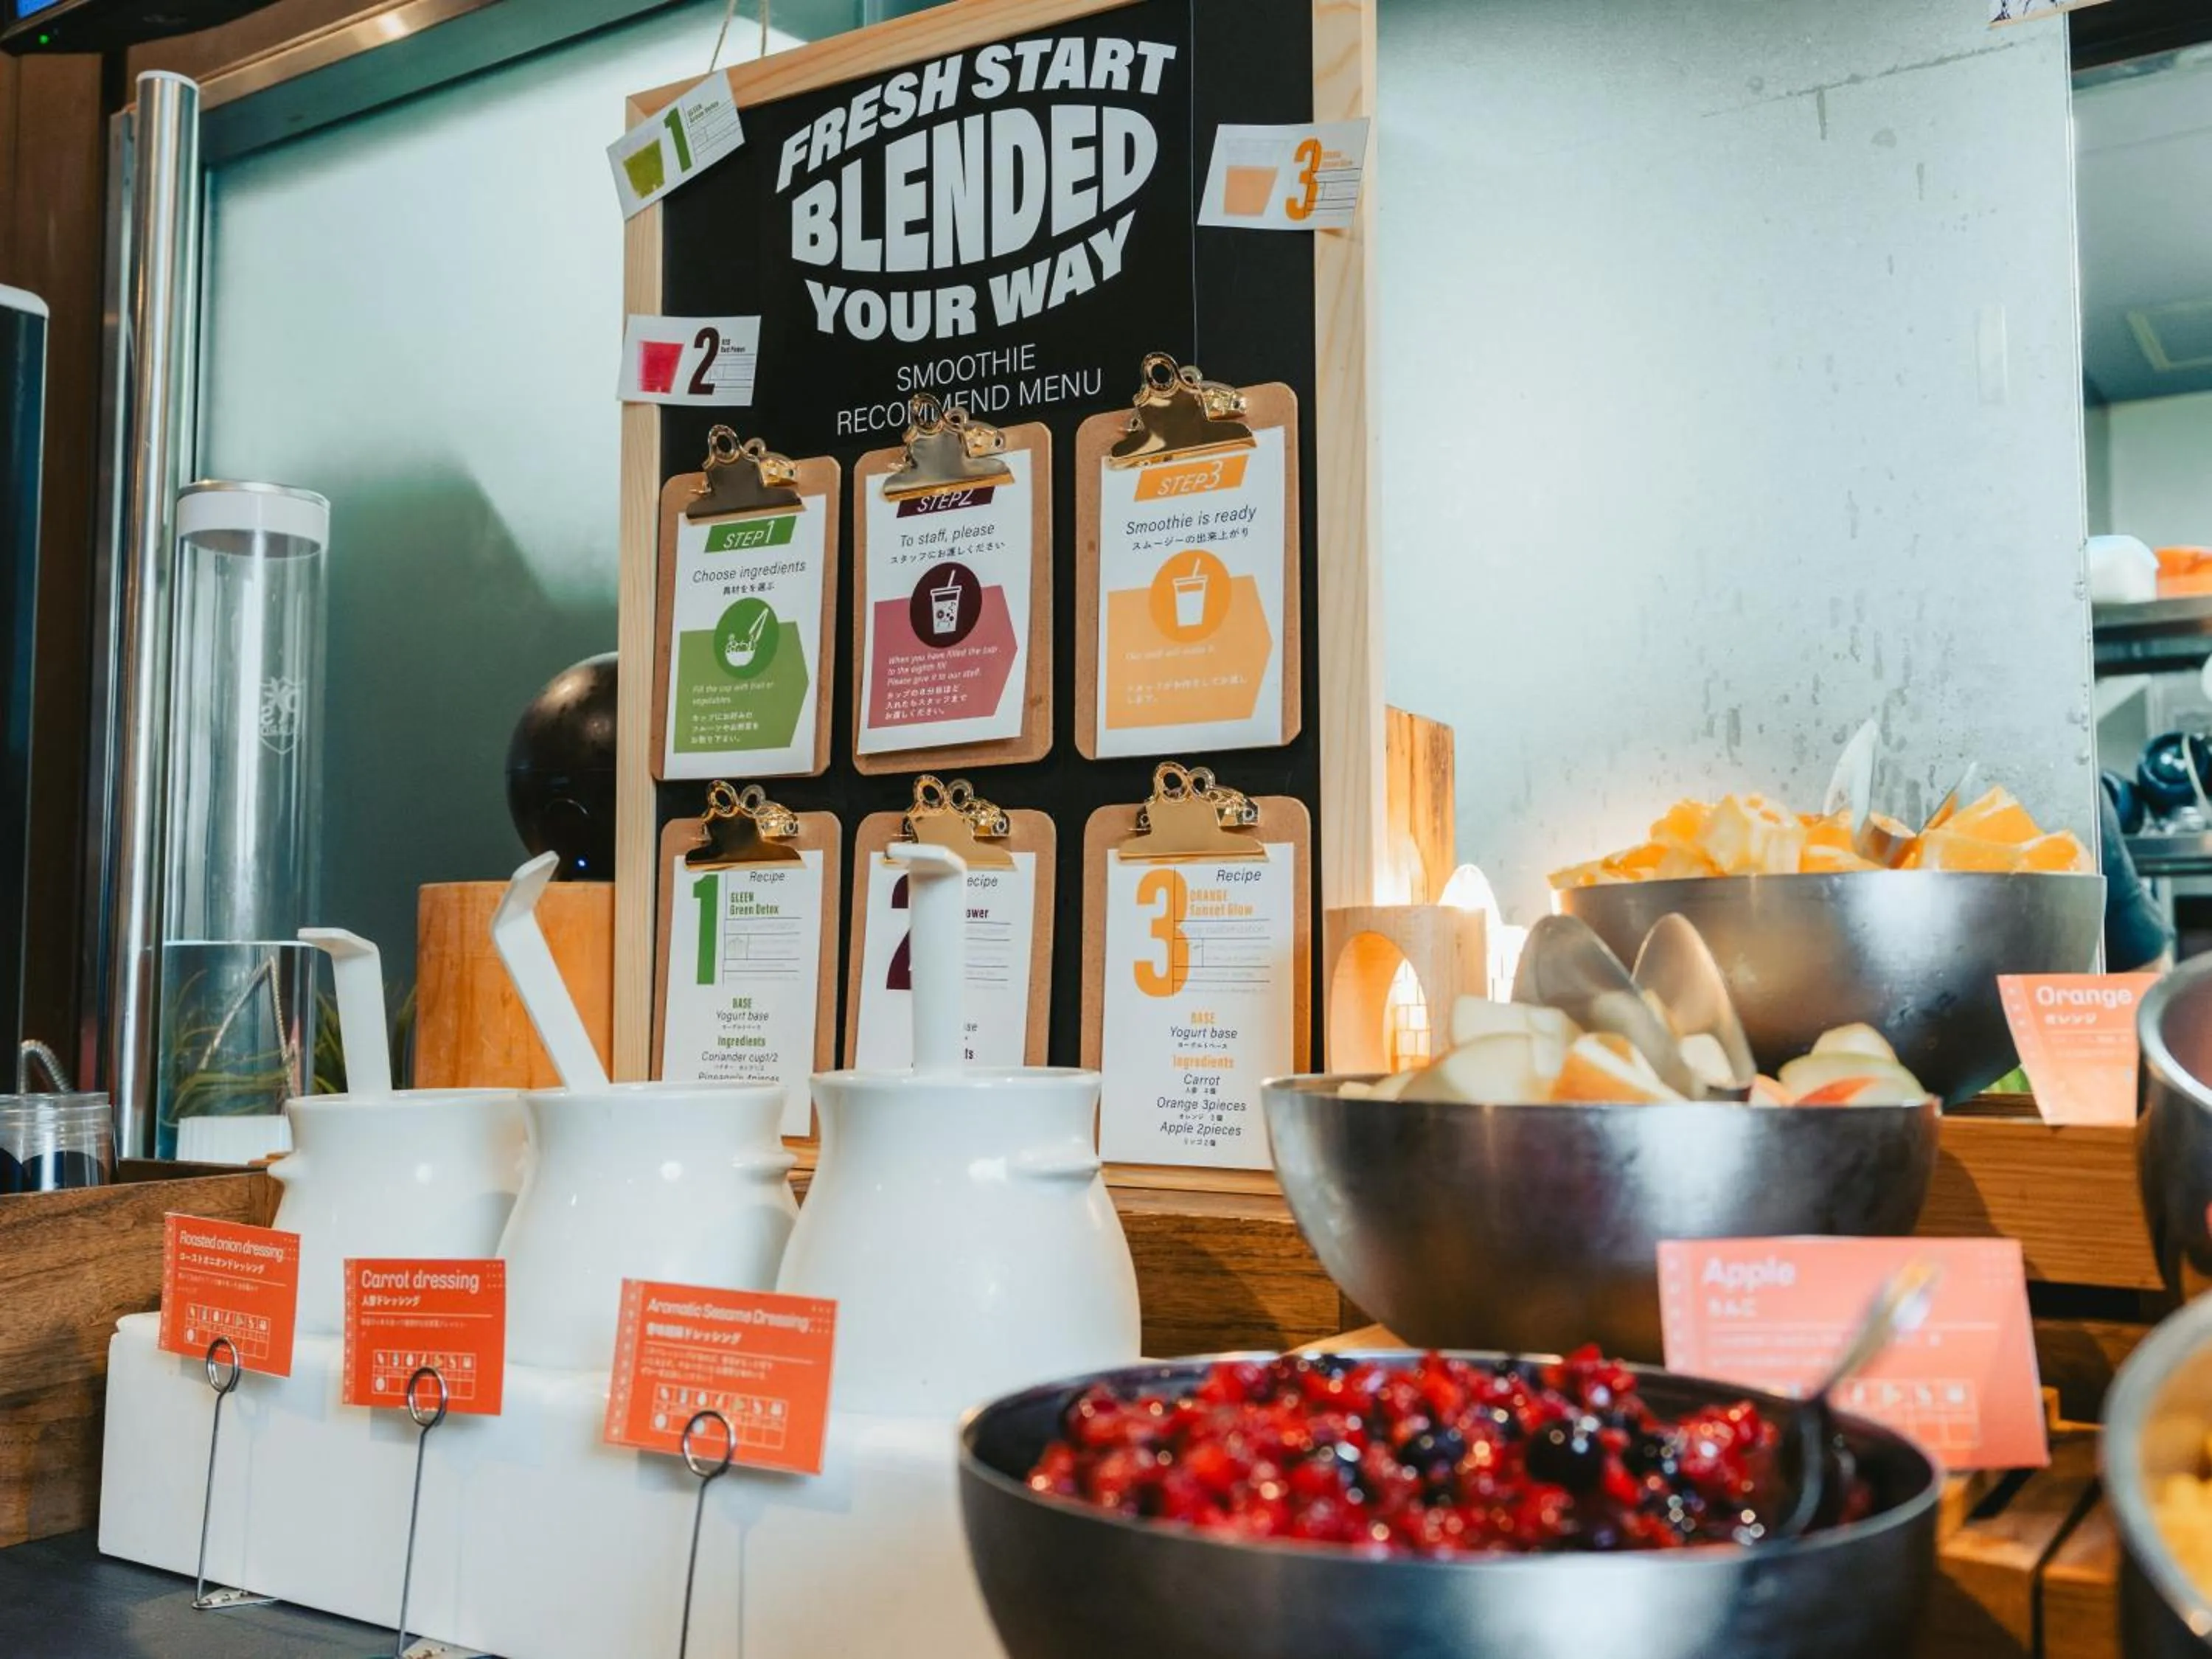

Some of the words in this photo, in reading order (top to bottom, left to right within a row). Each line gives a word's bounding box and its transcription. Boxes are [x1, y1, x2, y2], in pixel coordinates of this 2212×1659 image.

[776, 54, 965, 193] FRESH
[973, 37, 1176, 97] START
[664, 106, 692, 173] 1
[791, 104, 1158, 273] BLENDED
[1286, 137, 1321, 221] 3
[805, 279, 976, 342] YOUR
[988, 210, 1136, 323] WAY
[688, 327, 720, 395] 2
[897, 343, 1036, 392] SMOOTHIE
[1020, 367, 1102, 407] MENU
[1126, 515, 1192, 535] Smoothie
[1198, 510, 1209, 526] is
[1214, 504, 1256, 524] ready
[900, 533, 914, 548] To
[918, 529, 948, 547] staff,
[952, 524, 995, 543] please
[692, 568, 736, 583] Choose
[740, 560, 807, 580] ingredients
[750, 871, 785, 884] Recipe
[967, 874, 998, 888] ecipe
[1216, 869, 1262, 884] Recipe
[966, 908, 989, 919] ower
[693, 874, 718, 984] 1
[1133, 868, 1190, 998] 3
[732, 998, 752, 1009] BASE
[2035, 985, 2132, 1009] Orange
[717, 1010, 745, 1023] Yogurt
[748, 1011, 769, 1021] base
[717, 1035, 766, 1048] Ingredients
[1170, 1026, 1207, 1040] Yogurt
[1210, 1026, 1237, 1039] base
[701, 1051, 746, 1062] Coriander
[1173, 1054, 1234, 1069] Ingredients
[1183, 1074, 1220, 1086] Carrot
[1157, 1096, 1198, 1112] Orange
[1202, 1099, 1247, 1112] 3pieces
[1160, 1121, 1194, 1136] Apple
[1197, 1123, 1242, 1137] 2pieces
[180, 1230, 216, 1248] Roasted
[217, 1237, 242, 1252] onion
[243, 1239, 284, 1262] dressing
[362, 1268, 410, 1289] Carrot
[413, 1268, 479, 1295] dressing
[1702, 1256, 1795, 1292] Apple
[647, 1297, 700, 1318] Aromatic
